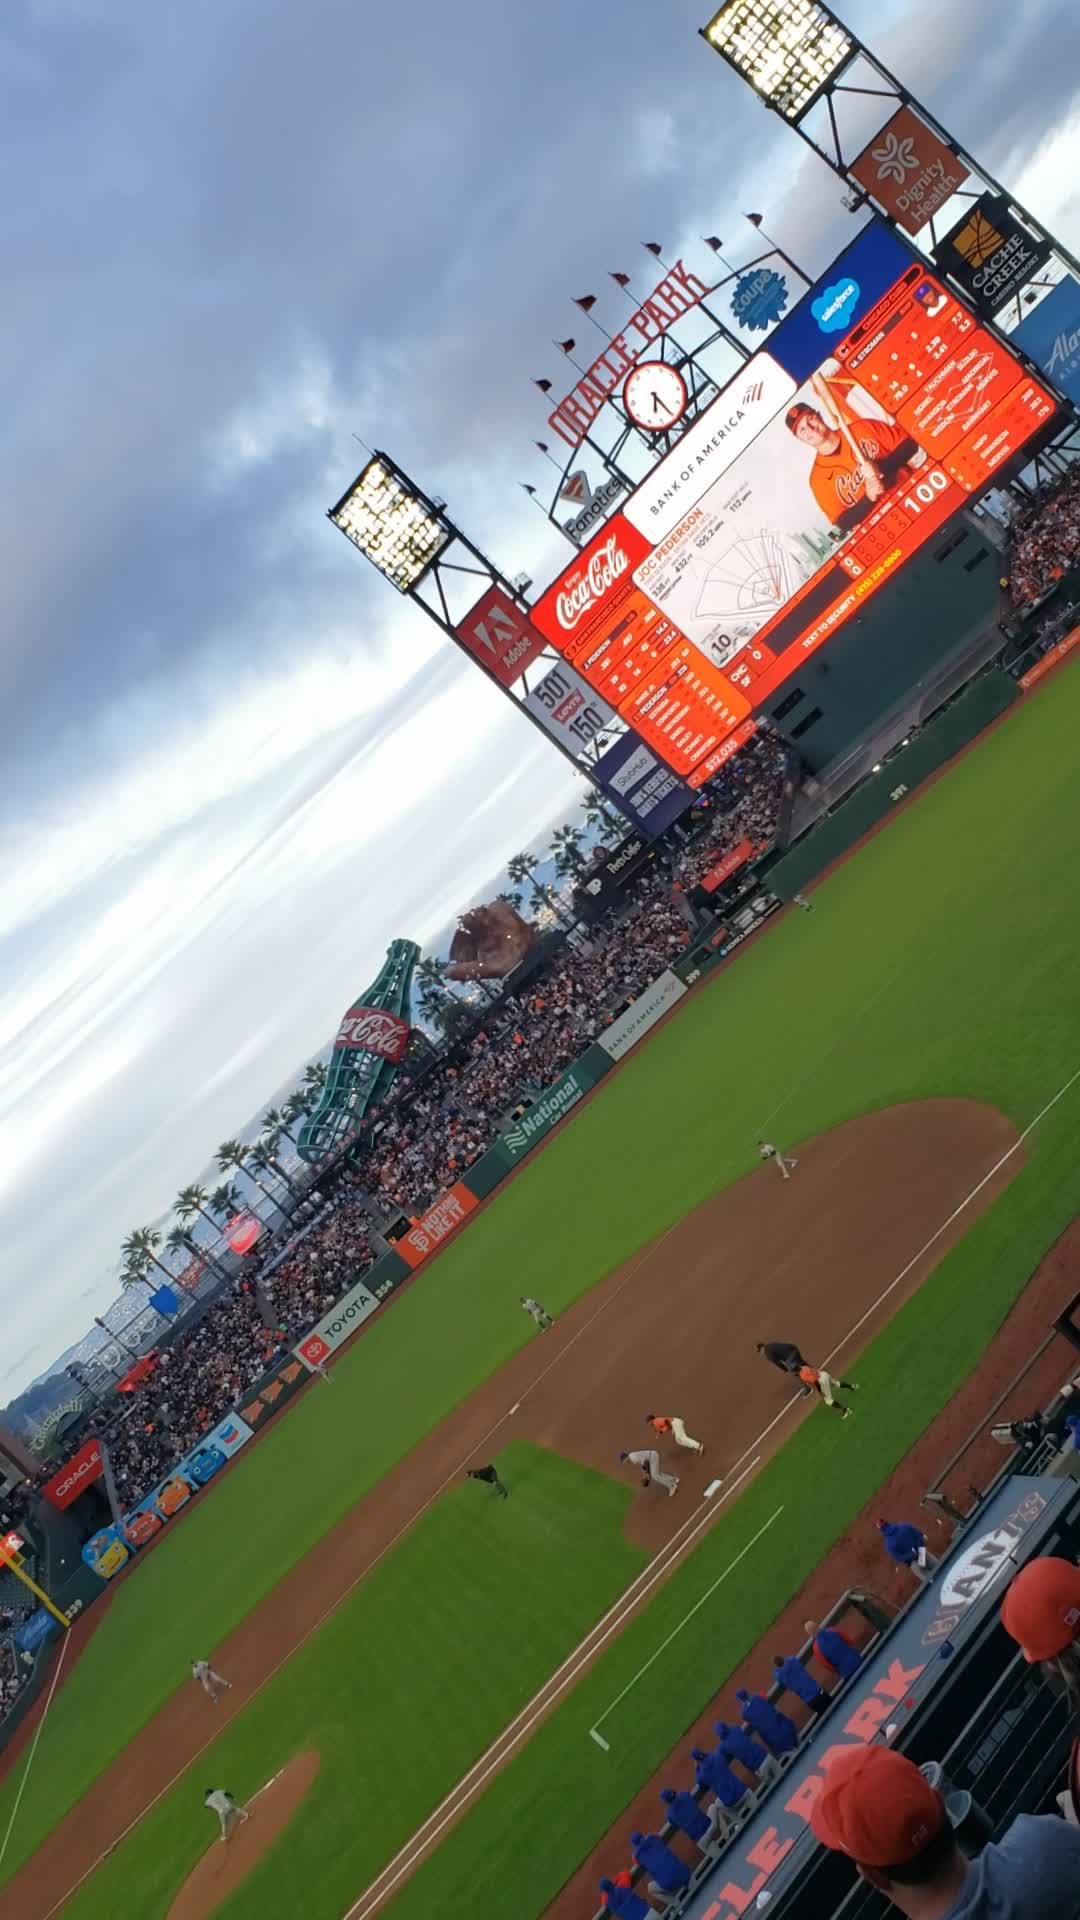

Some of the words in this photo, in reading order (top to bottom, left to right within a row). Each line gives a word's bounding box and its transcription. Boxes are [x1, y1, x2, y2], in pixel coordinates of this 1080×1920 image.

[896, 158, 947, 210] Dignity
[911, 173, 955, 221] Health
[971, 234, 1022, 288] CACHE
[981, 245, 1031, 297] CREEK
[734, 270, 772, 311] coupa
[820, 284, 855, 322] salesforce
[950, 310, 964, 325] 7.7
[548, 335, 641, 448] ORACLE
[628, 260, 710, 349] PARK
[856, 331, 885, 360] STROMAN
[946, 382, 974, 411] STROMAN
[649, 480, 681, 515] BANK
[679, 463, 695, 481] OF
[695, 409, 744, 463] AMERICA
[836, 441, 878, 504] Giats
[566, 477, 621, 538] Fanatics
[728, 498, 743, 513] 112
[636, 558, 656, 581] JOC
[655, 508, 702, 560] PEDERSON
[696, 529, 714, 549] 105.2
[561, 536, 628, 624] Coca-Cola
[674, 558, 688, 573] 432
[729, 664, 747, 682] CHC
[750, 648, 763, 661] 0
[842, 555, 855, 568] 0
[739, 673, 753, 687] SF
[850, 563, 863, 577] 0
[802, 631, 818, 648] TEXT
[816, 621, 828, 633] TO
[825, 594, 855, 625] SECURITY
[501, 635, 532, 668] Adobe
[710, 632, 732, 655] 10
[532, 670, 571, 710] 501
[639, 685, 668, 715] PEDERSON
[608, 1033, 626, 1052] BANK
[625, 1022, 636, 1034] OF
[635, 995, 664, 1024] AMERICA
[521, 1075, 578, 1135] National
[548, 1109, 562, 1125] Car
[560, 1088, 583, 1112] Rental
[429, 1215, 453, 1241] LIKE
[449, 1203, 465, 1221] IT
[375, 1278, 393, 1298] 354
[325, 1293, 369, 1339] TOYOTA
[56, 1452, 99, 1495] ORACLE
[920, 1490, 1047, 1647] GIANTS
[784, 1658, 927, 1823] PRK
